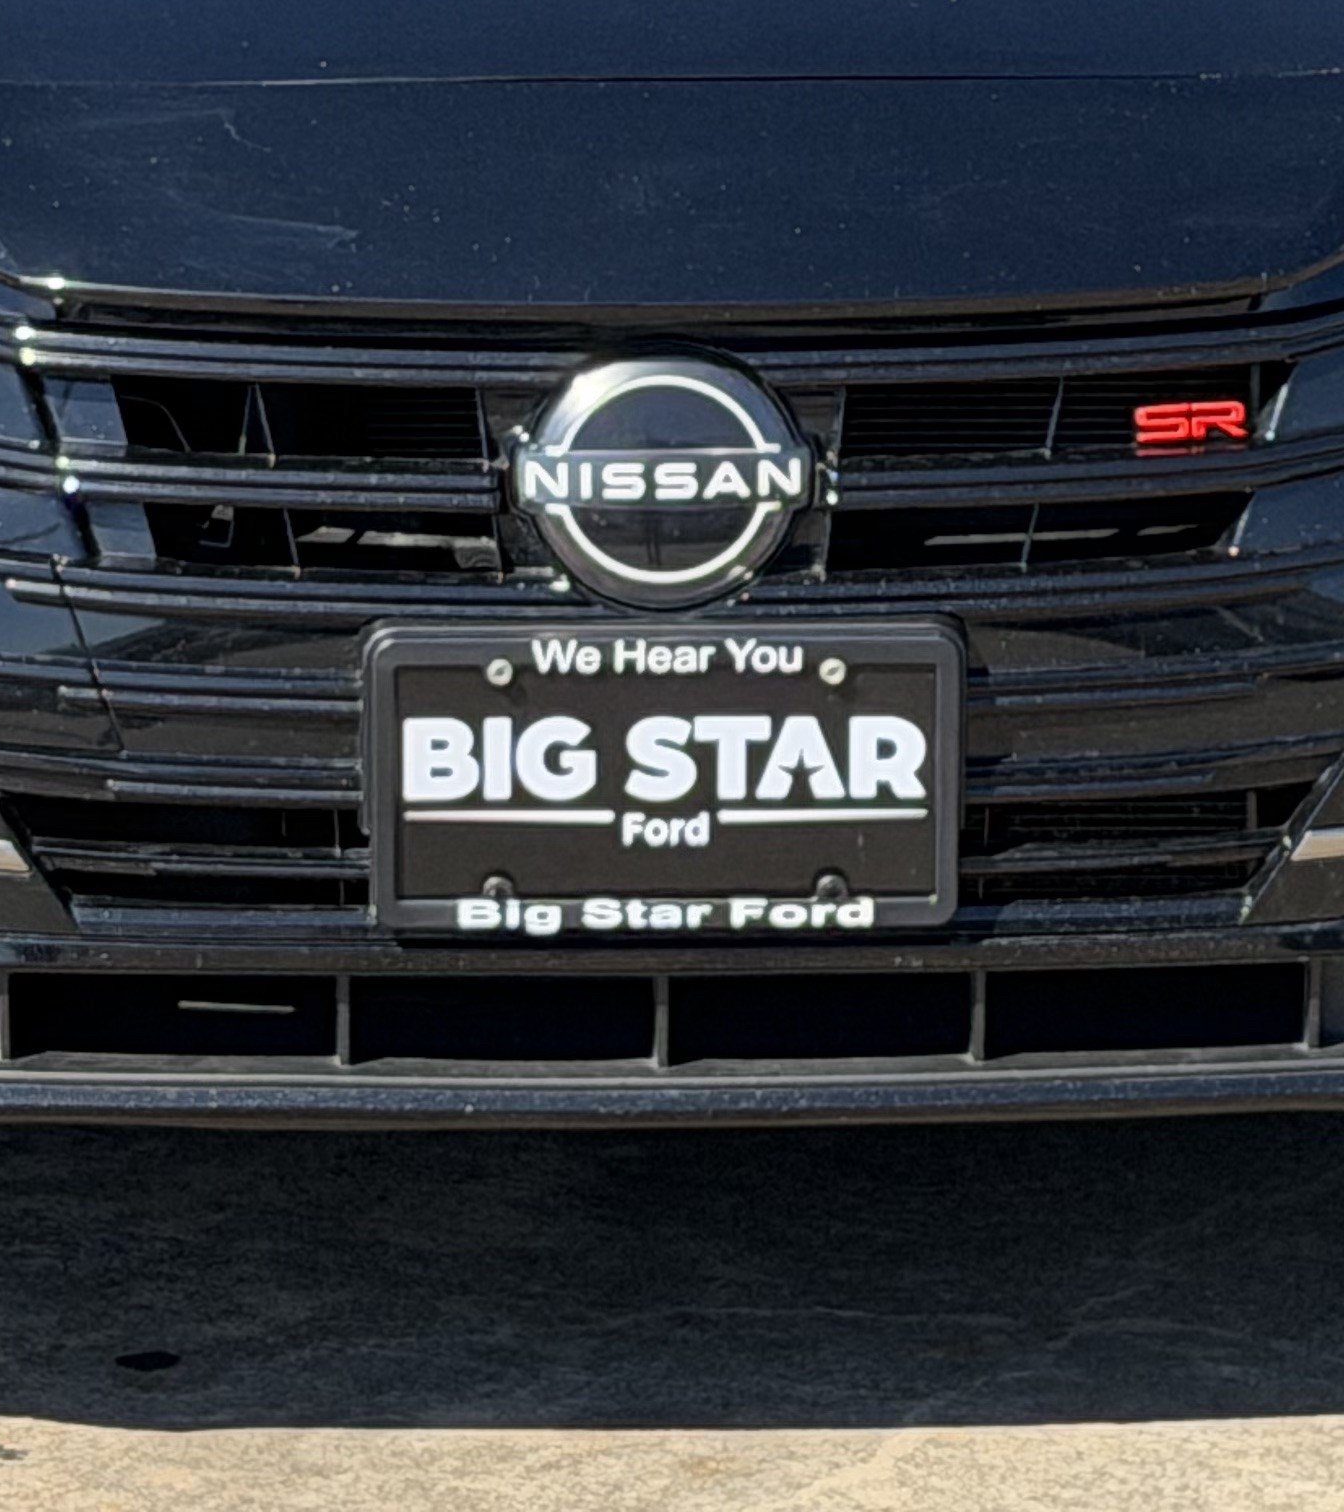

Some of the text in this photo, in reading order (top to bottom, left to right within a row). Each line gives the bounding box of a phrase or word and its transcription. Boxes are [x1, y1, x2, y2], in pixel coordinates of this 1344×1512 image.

[1135, 400, 1249, 443] SR
[523, 459, 802, 500] NISSAN
[531, 638, 804, 675] We Hear You
[402, 716, 927, 801] BIG STAR
[622, 810, 711, 847] Ford
[455, 896, 875, 935] Big Star Ford
